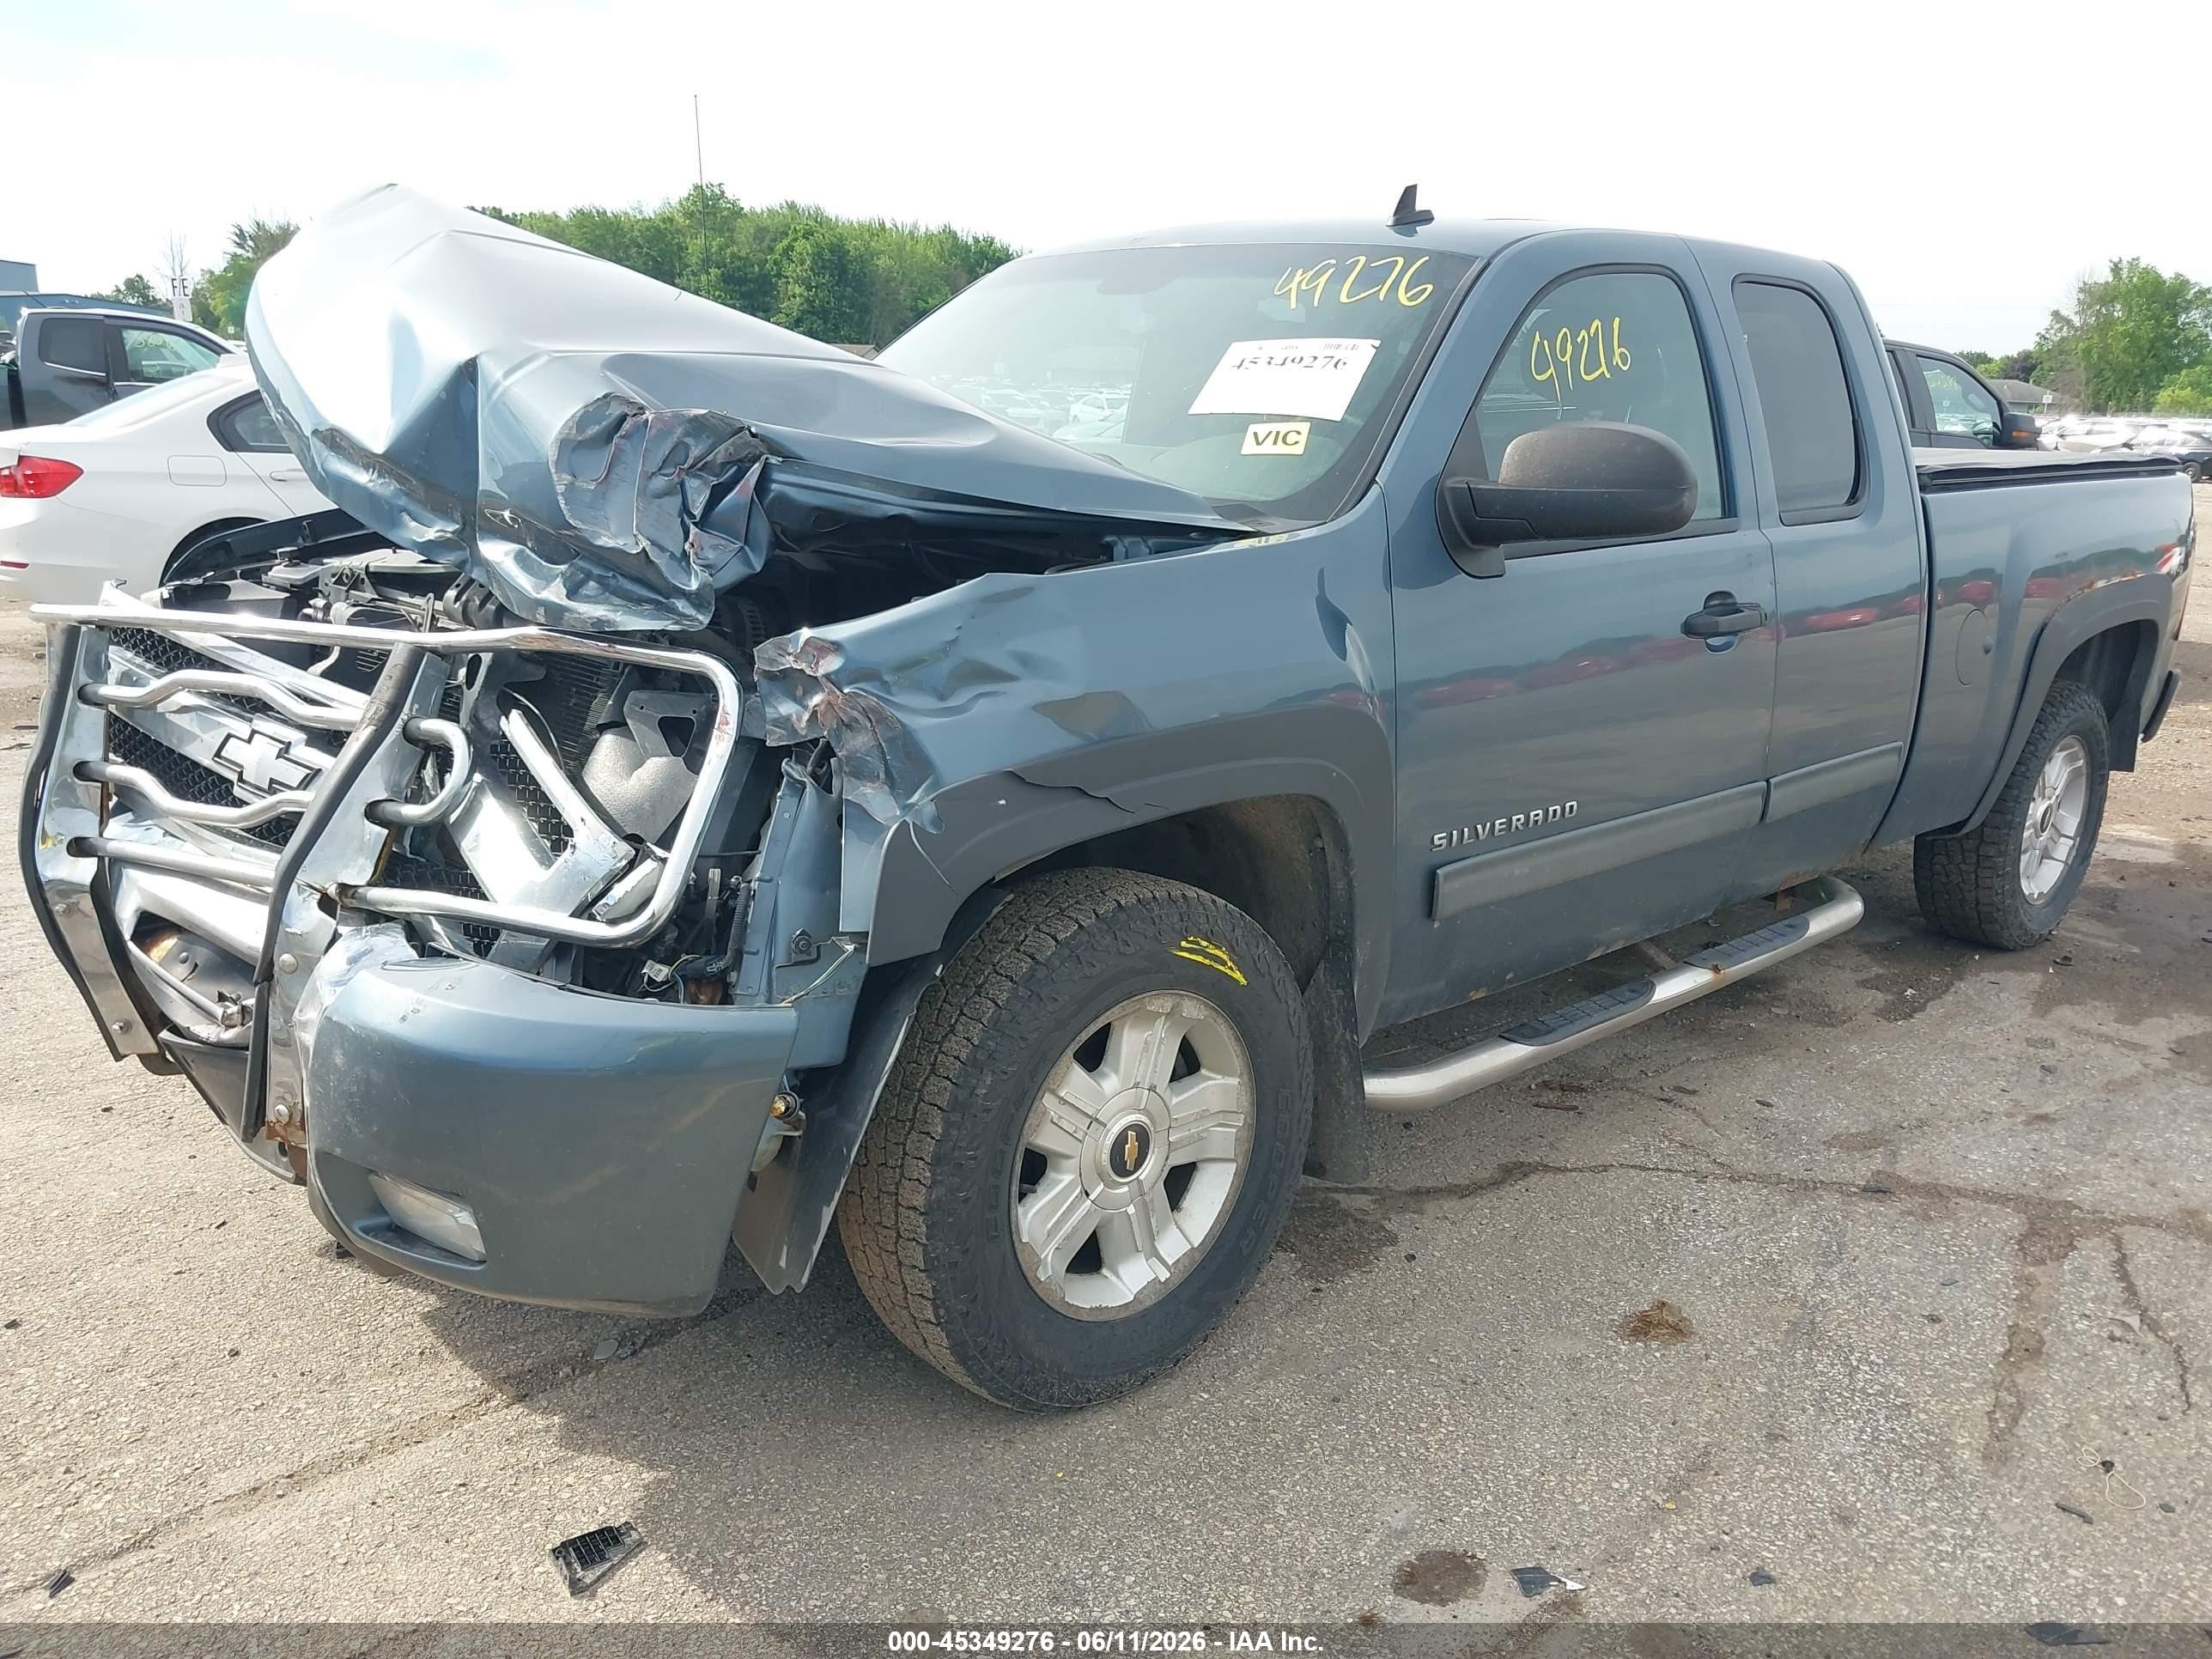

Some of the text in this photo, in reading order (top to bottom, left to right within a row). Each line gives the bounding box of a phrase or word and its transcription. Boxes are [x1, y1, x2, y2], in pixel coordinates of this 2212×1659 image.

[1273, 255, 1434, 310] 49276
[1251, 429, 1303, 447] VIC
[1430, 800, 1578, 852] SILVERADO
